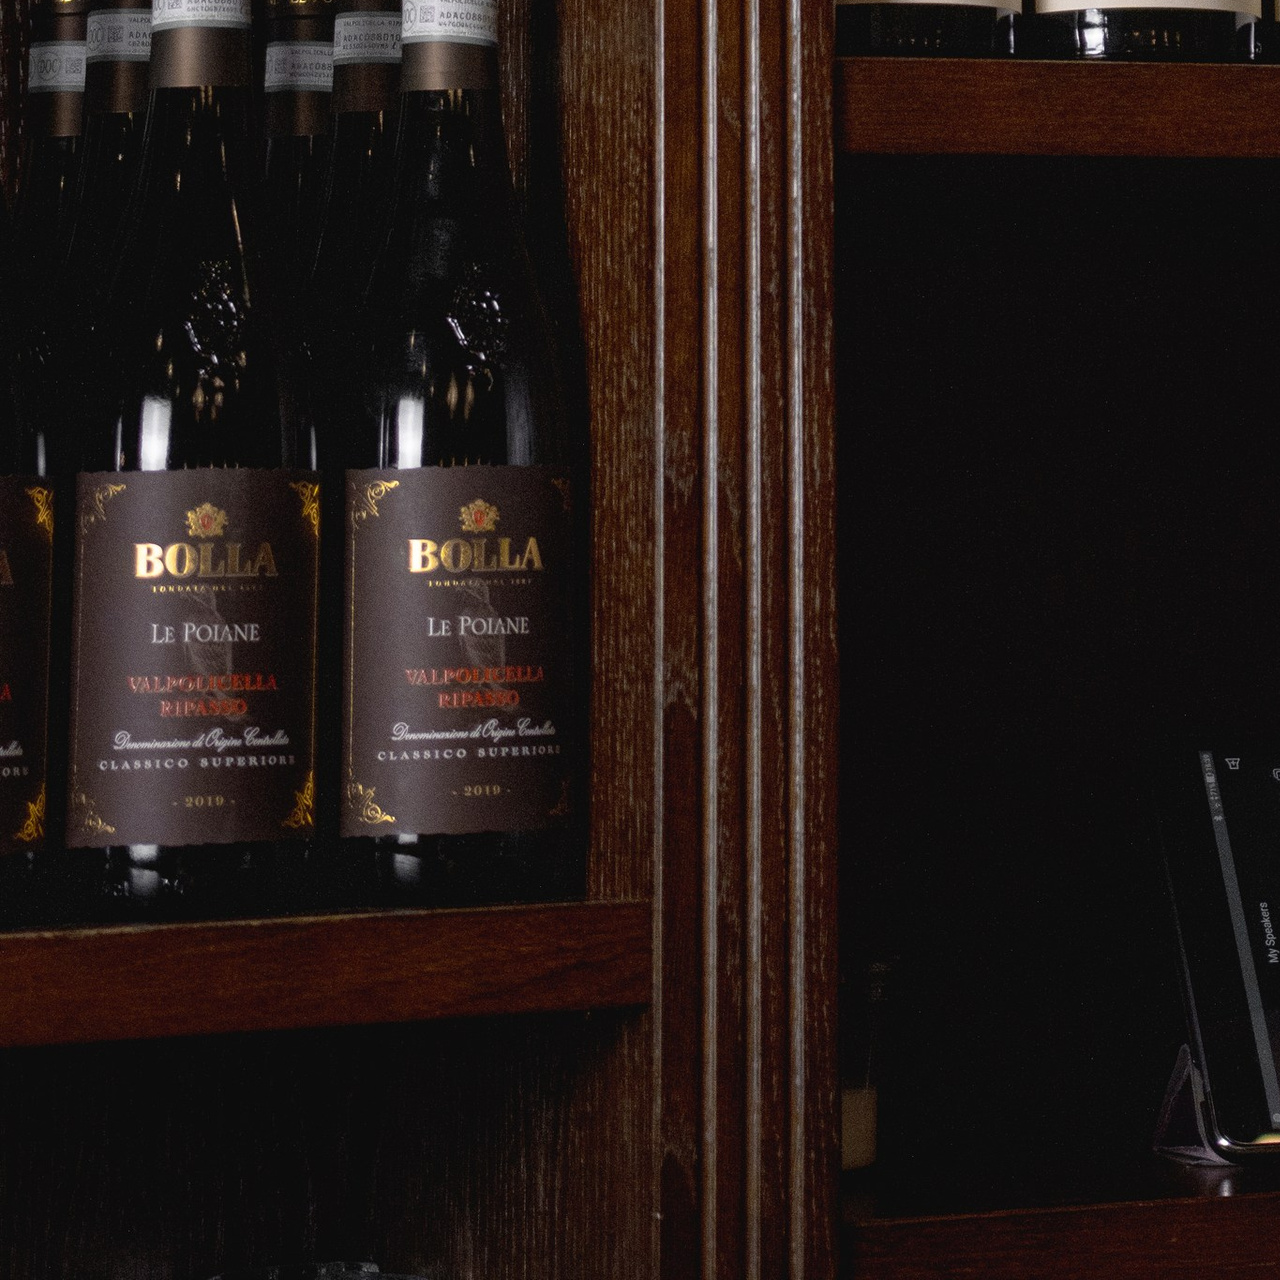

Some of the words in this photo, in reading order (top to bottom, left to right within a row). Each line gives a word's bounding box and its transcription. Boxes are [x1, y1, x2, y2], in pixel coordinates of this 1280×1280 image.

[134, 541, 279, 579] BOLLA
[407, 536, 545, 573] BOLLA
[183, 622, 261, 643] POIANE
[458, 615, 530, 635] POIANE
[160, 698, 248, 717] RIPASSO
[113, 730, 191, 751] Denominazione
[99, 758, 189, 771] CLASSICO
[199, 754, 295, 768] SUPERIORE
[377, 748, 467, 762] CLASSICO
[478, 745, 561, 758] SUPERIORE
[1258, 901, 1277, 947] Speakers
[1267, 947, 1280, 964] My
